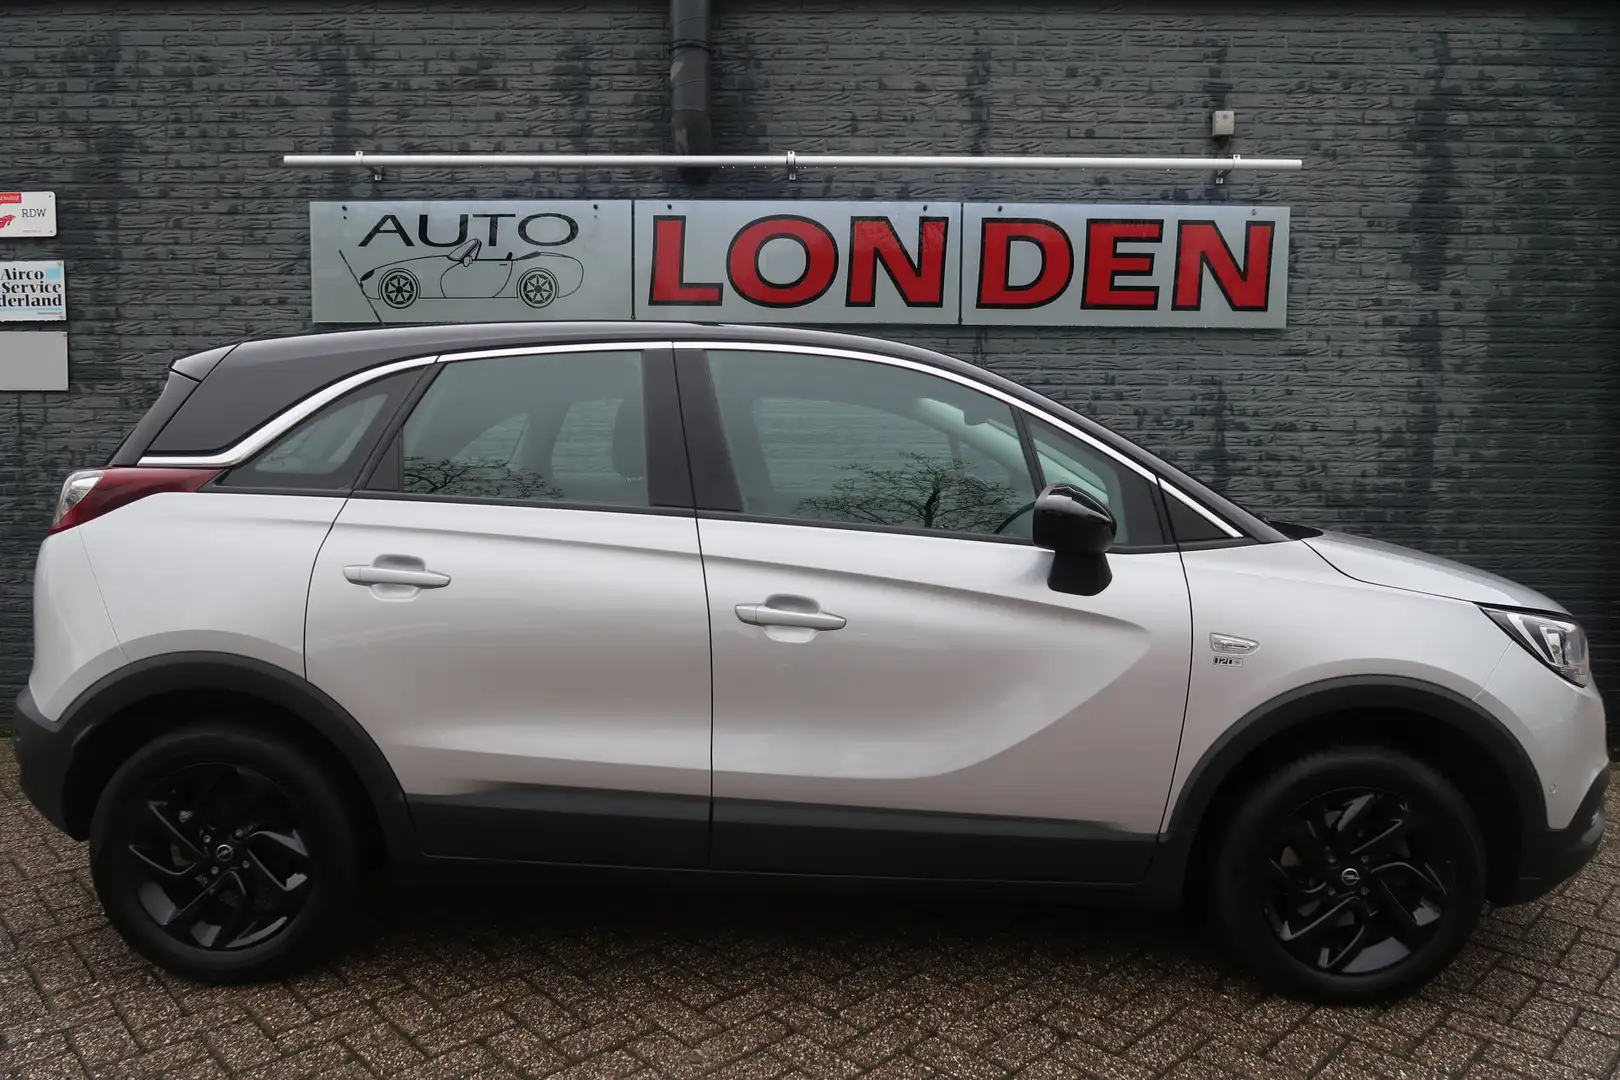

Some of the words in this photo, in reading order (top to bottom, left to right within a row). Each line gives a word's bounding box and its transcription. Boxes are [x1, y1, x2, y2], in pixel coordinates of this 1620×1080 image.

[21, 208, 47, 218] RDW
[357, 213, 580, 247] AUTO
[647, 213, 1277, 312] LONDEN
[1, 267, 45, 280] Airco
[1, 281, 62, 293] Service
